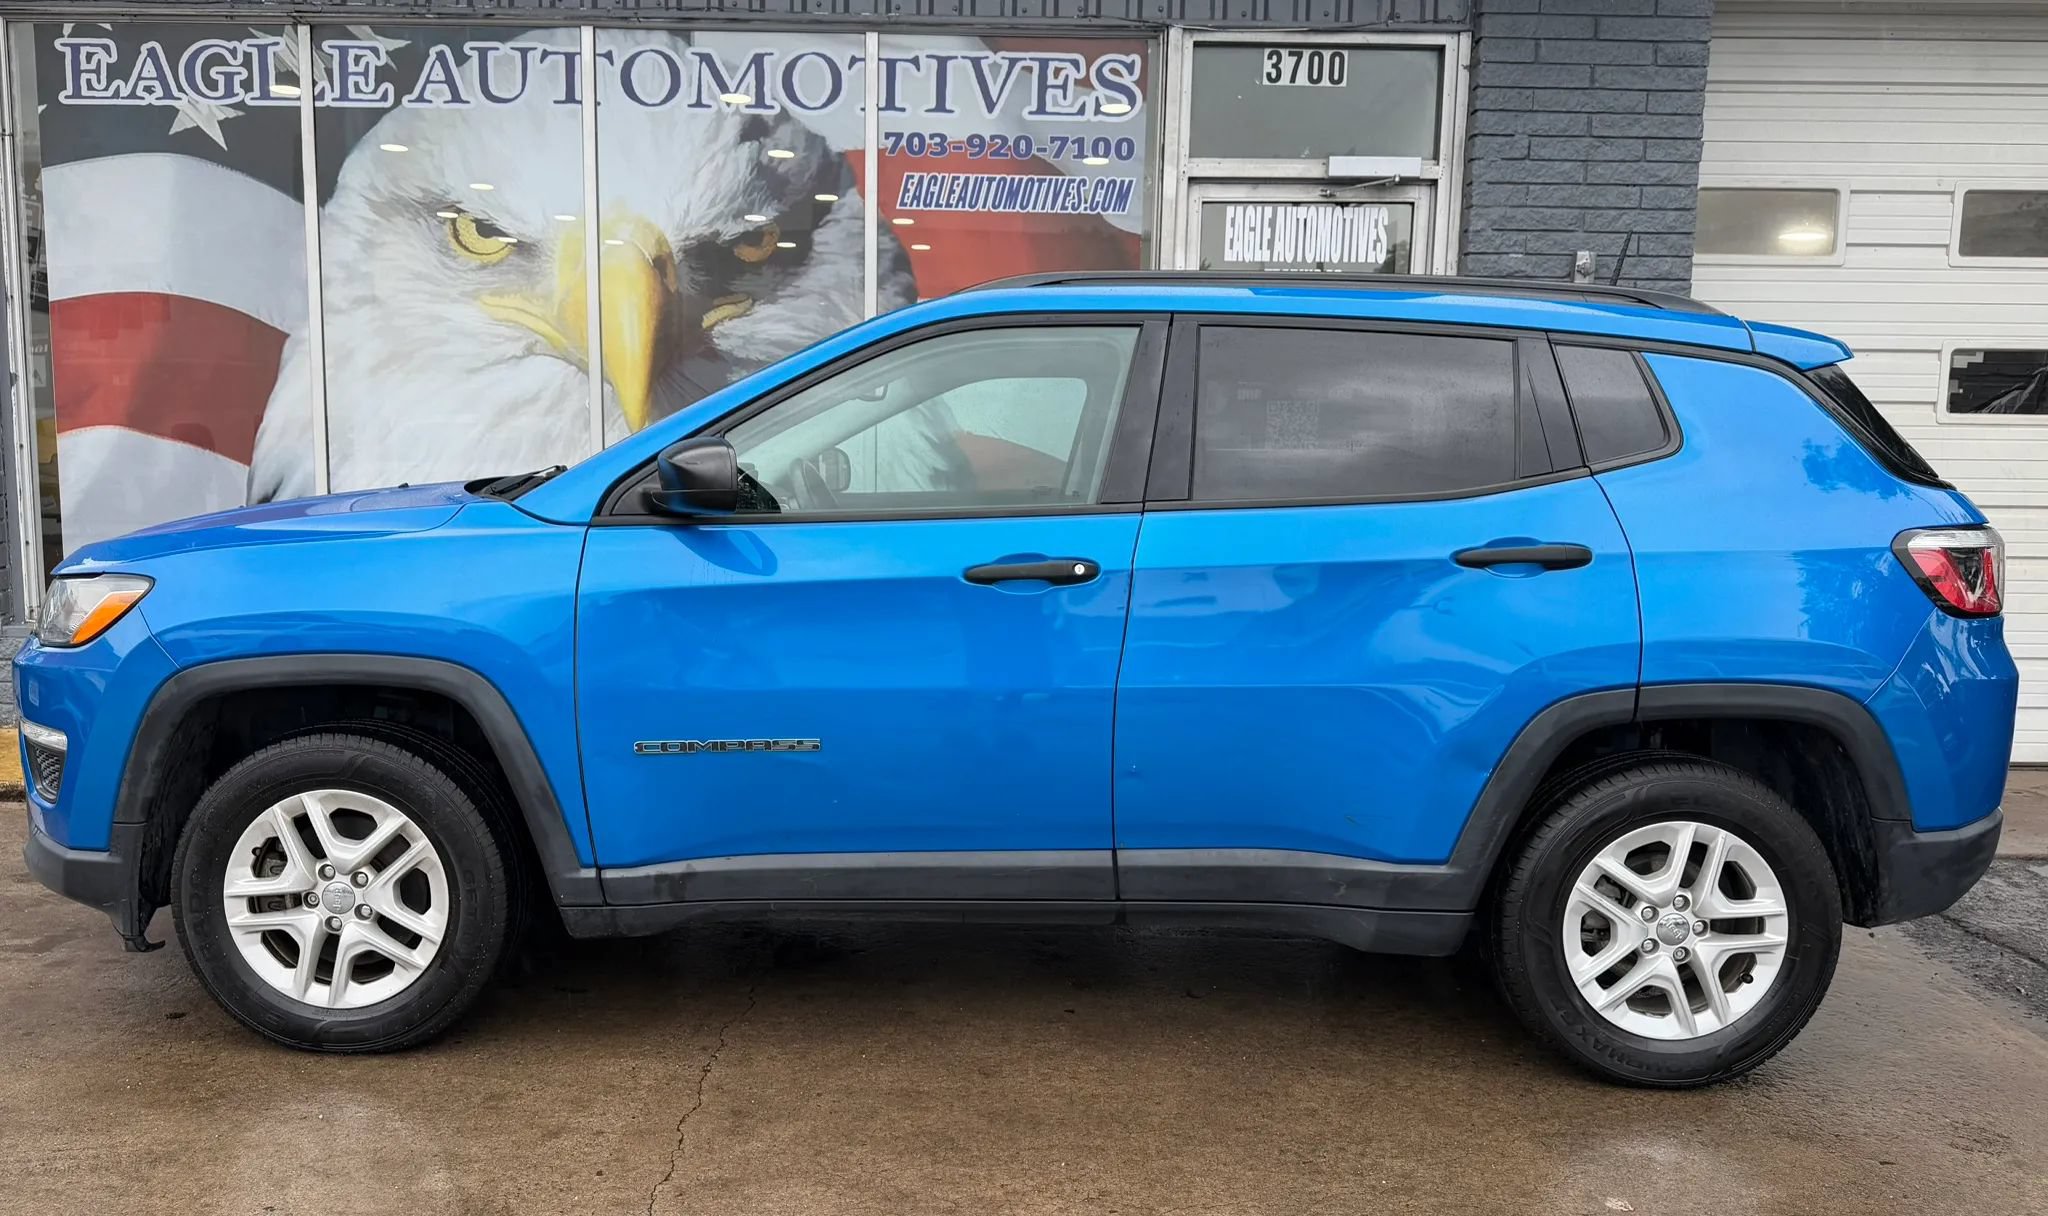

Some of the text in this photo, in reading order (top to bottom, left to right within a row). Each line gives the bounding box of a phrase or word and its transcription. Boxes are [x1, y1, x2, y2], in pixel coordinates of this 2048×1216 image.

[56, 38, 1144, 121] EAGLE AUTOMOTIVES
[1265, 49, 1346, 86] 3700
[884, 131, 1136, 162] 703-920-7100
[897, 173, 1136, 214] EAGLEAUTOMOTIVES.COM
[1224, 205, 1389, 265] EAGLE AUTOMOTIVES
[633, 738, 821, 754] COMPASS
